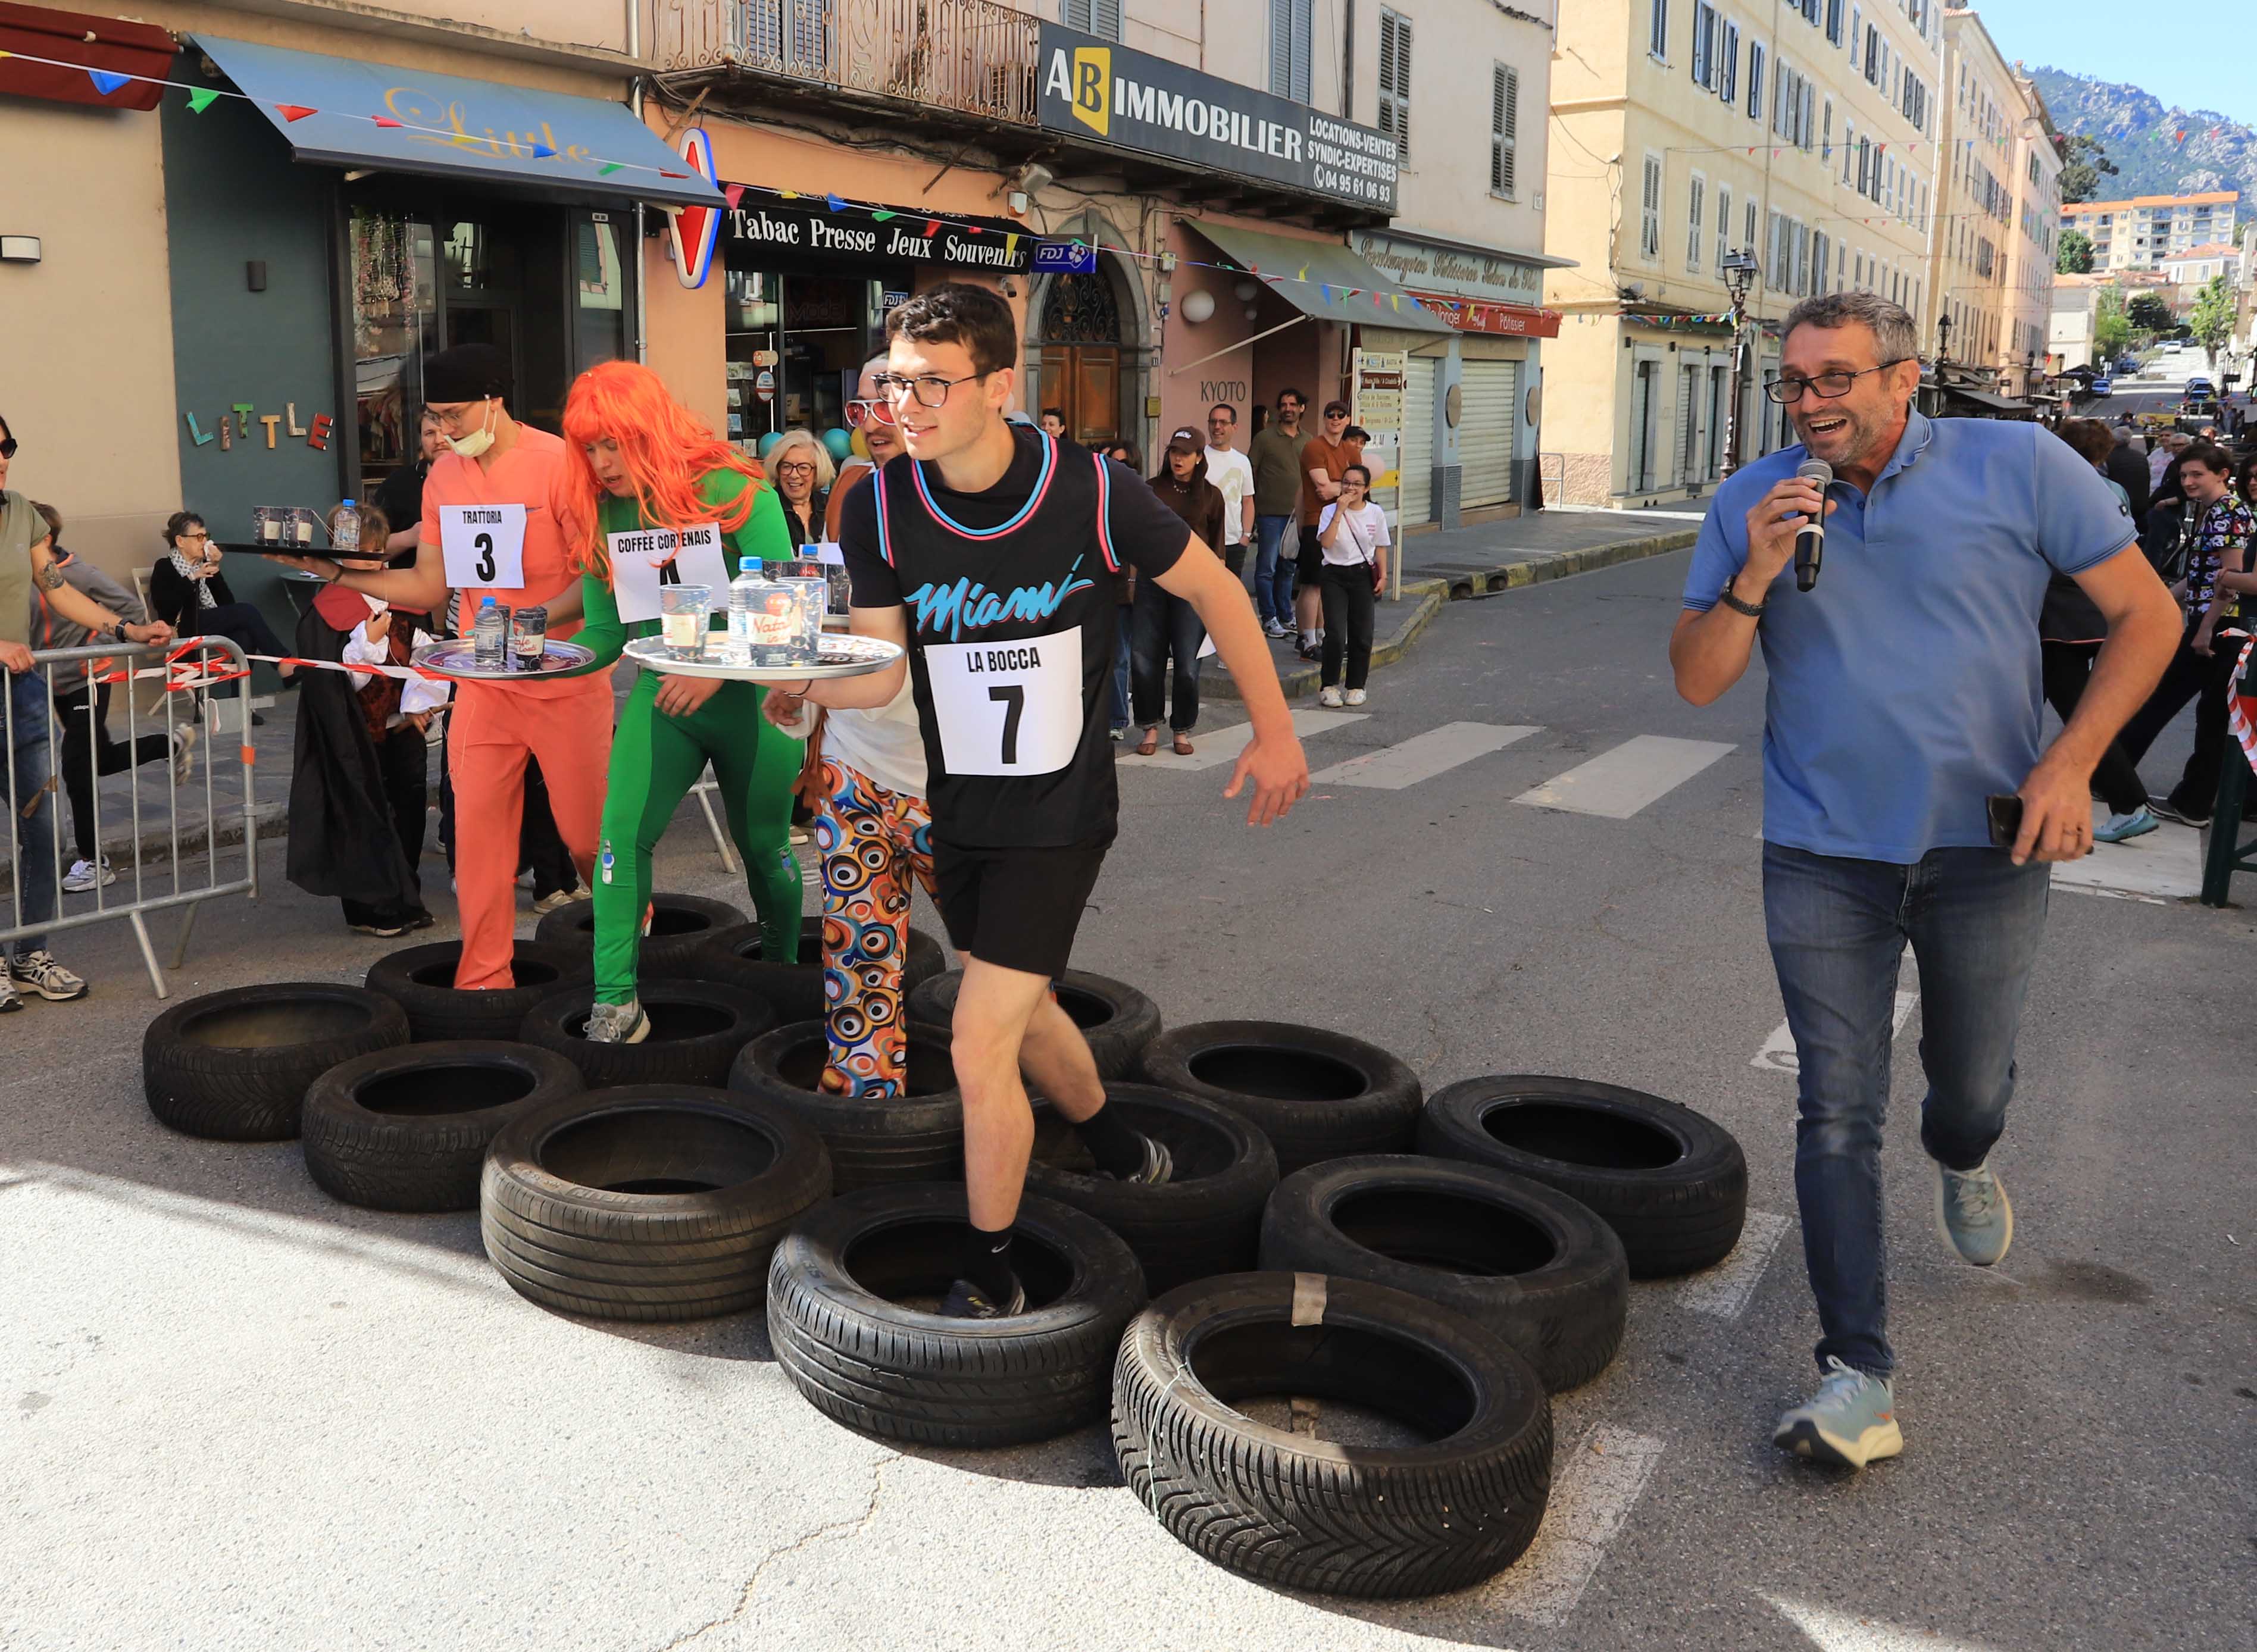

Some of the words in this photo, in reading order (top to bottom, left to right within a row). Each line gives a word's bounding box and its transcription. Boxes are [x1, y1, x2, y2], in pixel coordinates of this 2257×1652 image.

[1114, 77, 1303, 163] IMMOBILIER
[1309, 115, 1397, 161] LOCATIONS-VENTES
[1308, 140, 1397, 183] SYNDIC-EXPERTISES
[1325, 170, 1337, 190] 04
[1339, 174, 1351, 193] 95
[1353, 178, 1364, 196] 61
[1367, 181, 1378, 199] 06
[1379, 184, 1390, 202] 93
[729, 209, 800, 245] Tabac
[809, 218, 876, 252] Presse
[886, 227, 933, 259] Jeux
[1039, 248, 1064, 260] FDJ
[884, 295, 899, 305] FDJ
[1201, 381, 1246, 402] KYOTO
[185, 402, 333, 451] LITTLE
[462, 511, 502, 524] TRATTORIA
[474, 533, 496, 582] 3
[618, 536, 655, 553] COFFEE
[658, 530, 711, 550] CORENAIS
[904, 553, 1095, 643] Miami
[967, 651, 984, 672] LA
[987, 647, 1042, 672] BOCCA
[989, 685, 1024, 764] 7
